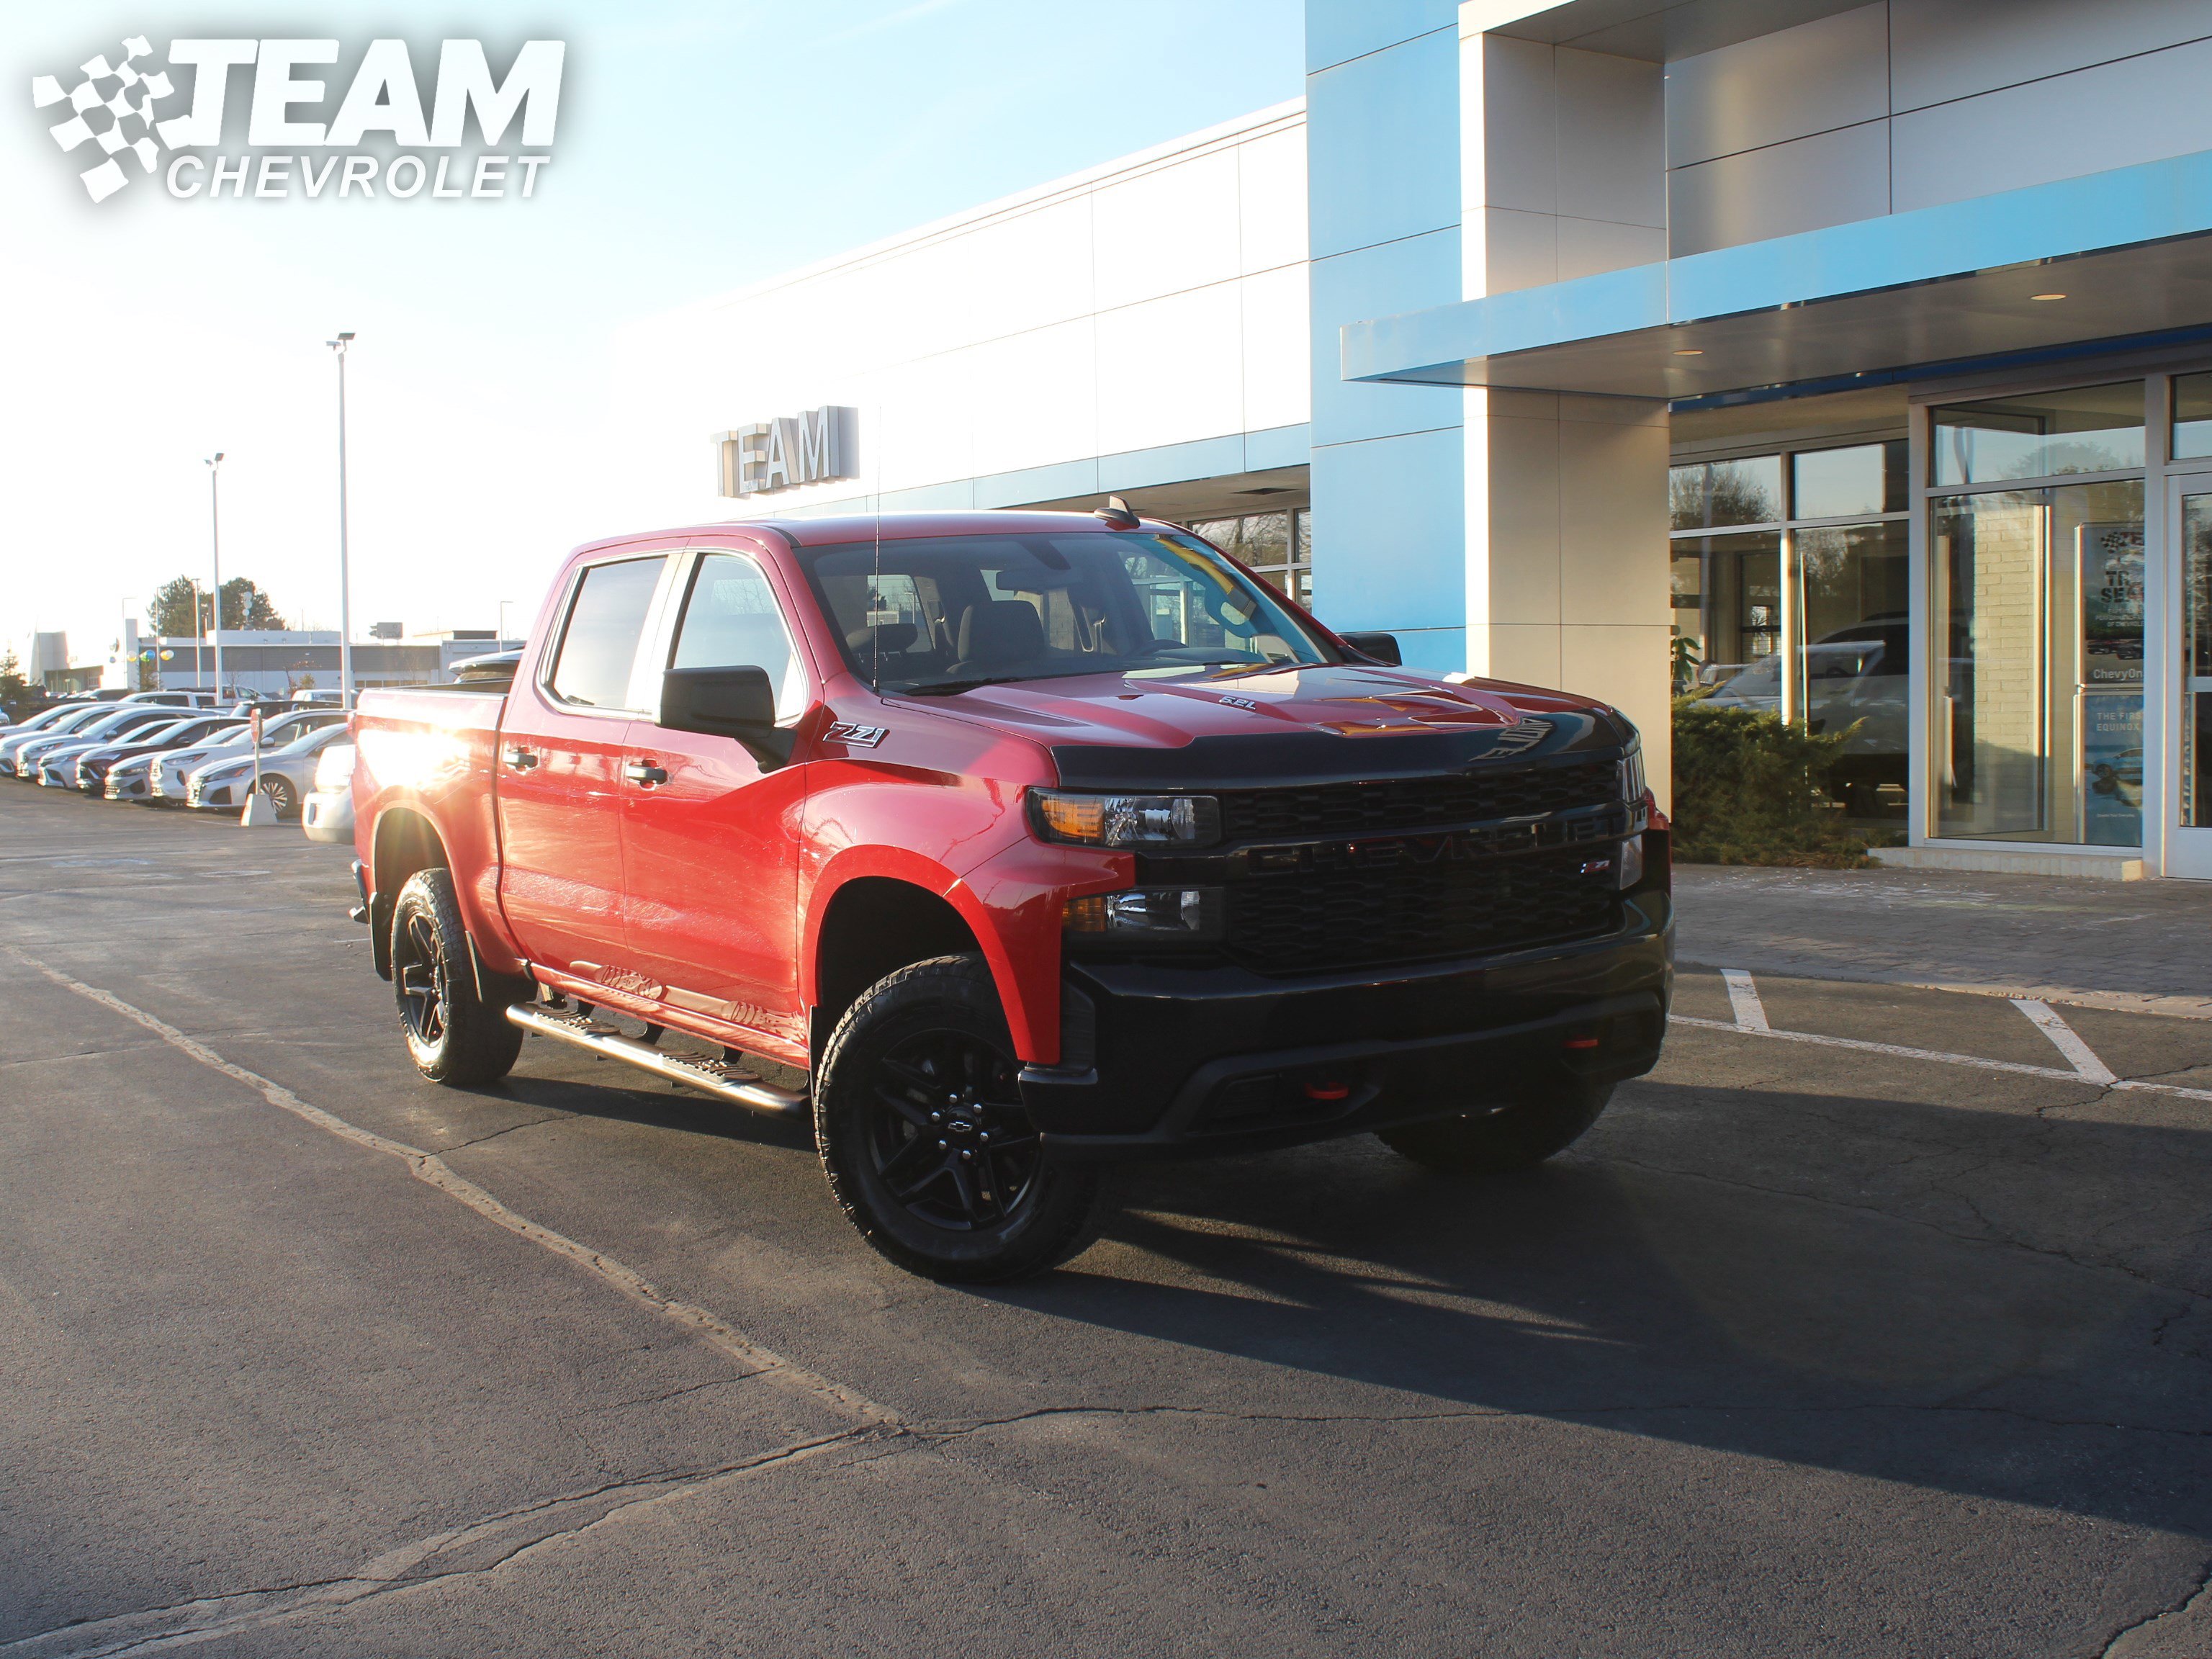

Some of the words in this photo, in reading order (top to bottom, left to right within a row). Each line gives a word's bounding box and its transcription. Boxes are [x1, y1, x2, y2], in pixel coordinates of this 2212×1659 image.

[710, 405, 844, 497] TEAM
[823, 721, 890, 749] Z71
[2096, 723, 2139, 732] EQUINOX
